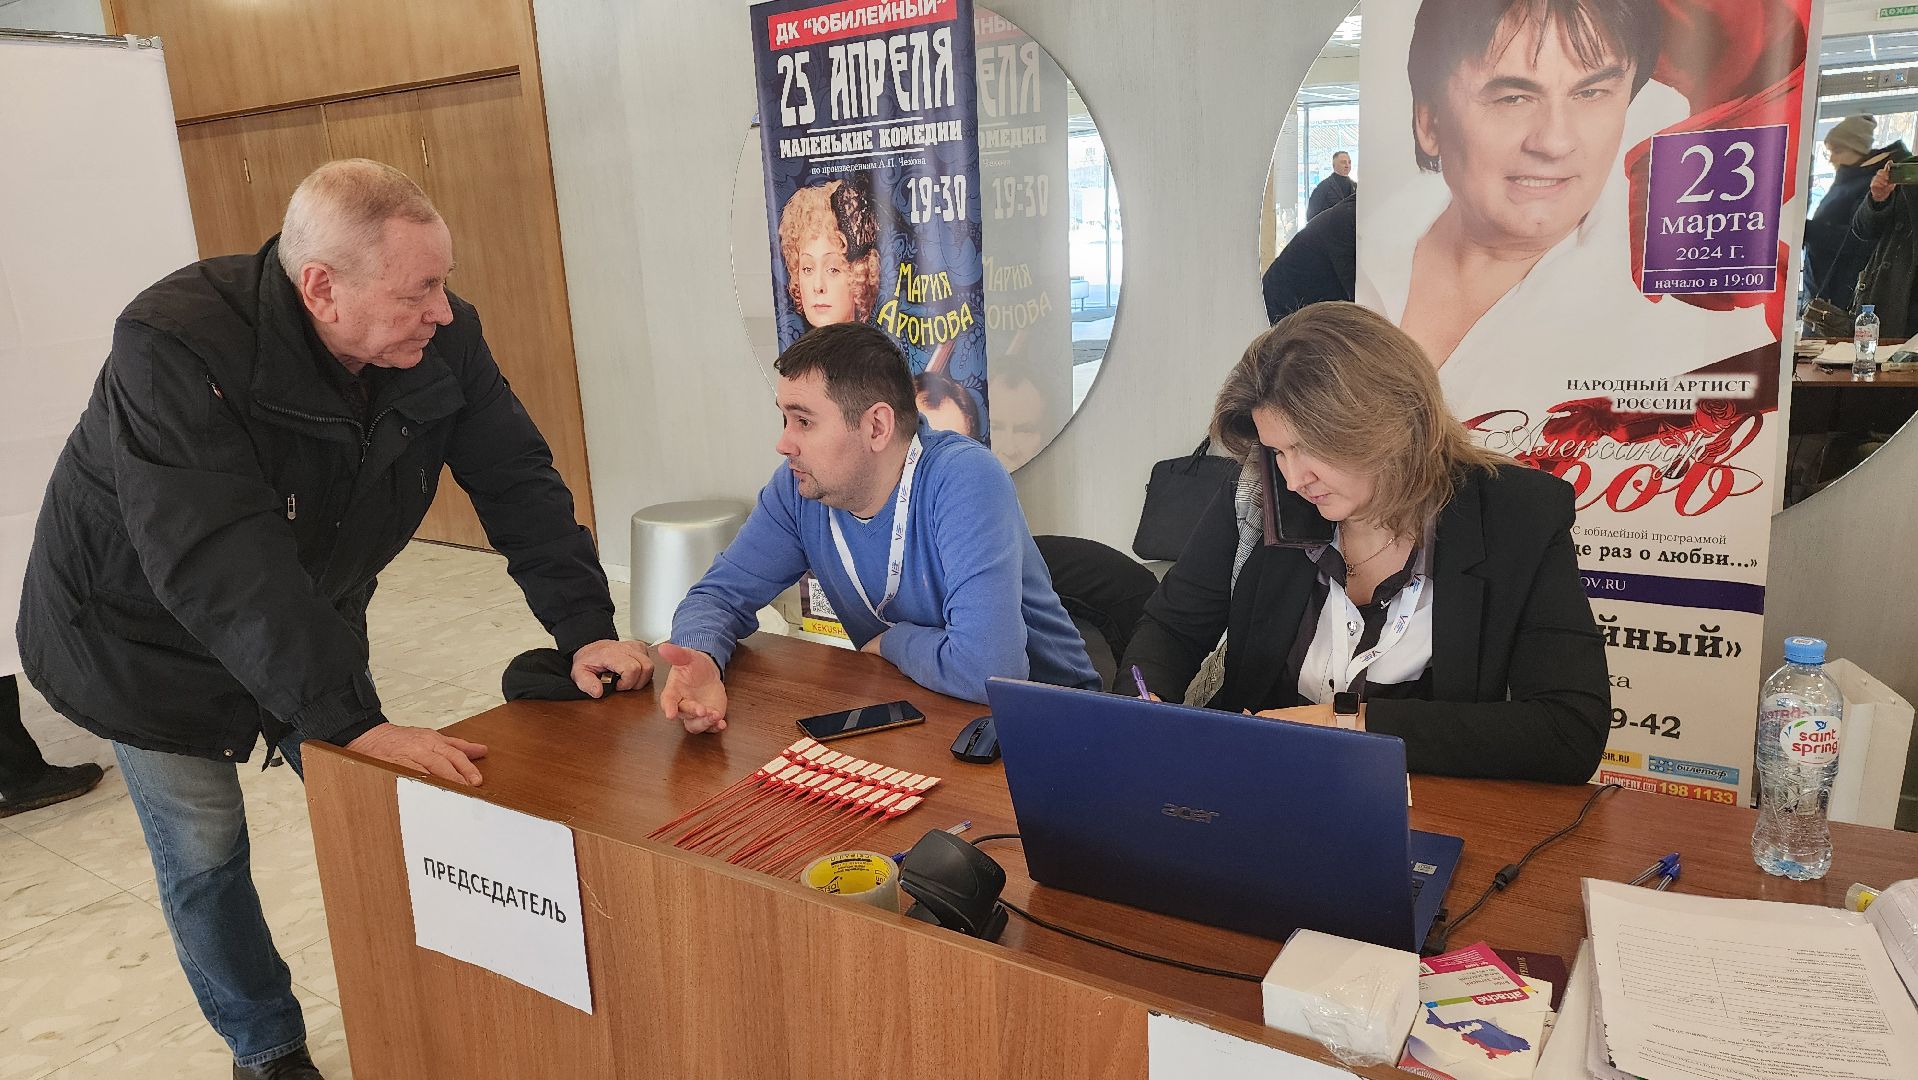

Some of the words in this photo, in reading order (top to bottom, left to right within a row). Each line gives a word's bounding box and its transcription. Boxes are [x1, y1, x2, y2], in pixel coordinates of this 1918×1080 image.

[776, 21, 800, 45] ДК
[777, 51, 816, 127] 25
[829, 27, 956, 120] АПРЕЛЯ
[780, 130, 873, 158] МАЛЕНЬКИЕ
[879, 120, 962, 147] КОМЕДИИ
[979, 125, 1047, 148] ОМЕДИИ
[811, 167, 821, 175] по
[900, 157, 926, 167] Чехова
[1676, 141, 1755, 203] 23
[907, 175, 967, 224] 19:30
[992, 175, 1049, 219] 19:30
[1660, 211, 1765, 240] марта
[1676, 246, 1722, 260] 2024
[1655, 277, 1705, 289] начало
[1709, 278, 1718, 287] в
[1724, 274, 1764, 287] 19:00
[1567, 378, 1668, 392] НАРОДНЫЙ
[1674, 379, 1750, 392] АРТИСТ
[1616, 397, 1692, 411] РОССИИ
[1573, 526, 1581, 535] С
[1584, 527, 1648, 540] юбилейной
[1652, 532, 1727, 545] программой
[1599, 545, 1632, 561] раз
[1640, 549, 1651, 560] о
[1580, 576, 1626, 591] OV.RU
[812, 623, 847, 636] KEKUSH
[1599, 614, 1742, 658] йный»
[1610, 707, 1682, 740] 9-42
[1800, 729, 1837, 742] saint
[1602, 752, 1630, 764] SIR.RU
[1792, 741, 1838, 756] spring
[1660, 782, 1689, 797] 198
[1694, 787, 1734, 805] 1133
[1161, 803, 1220, 824] acer
[424, 857, 567, 924] ПРЕДСЕДАТЕЛЬ
